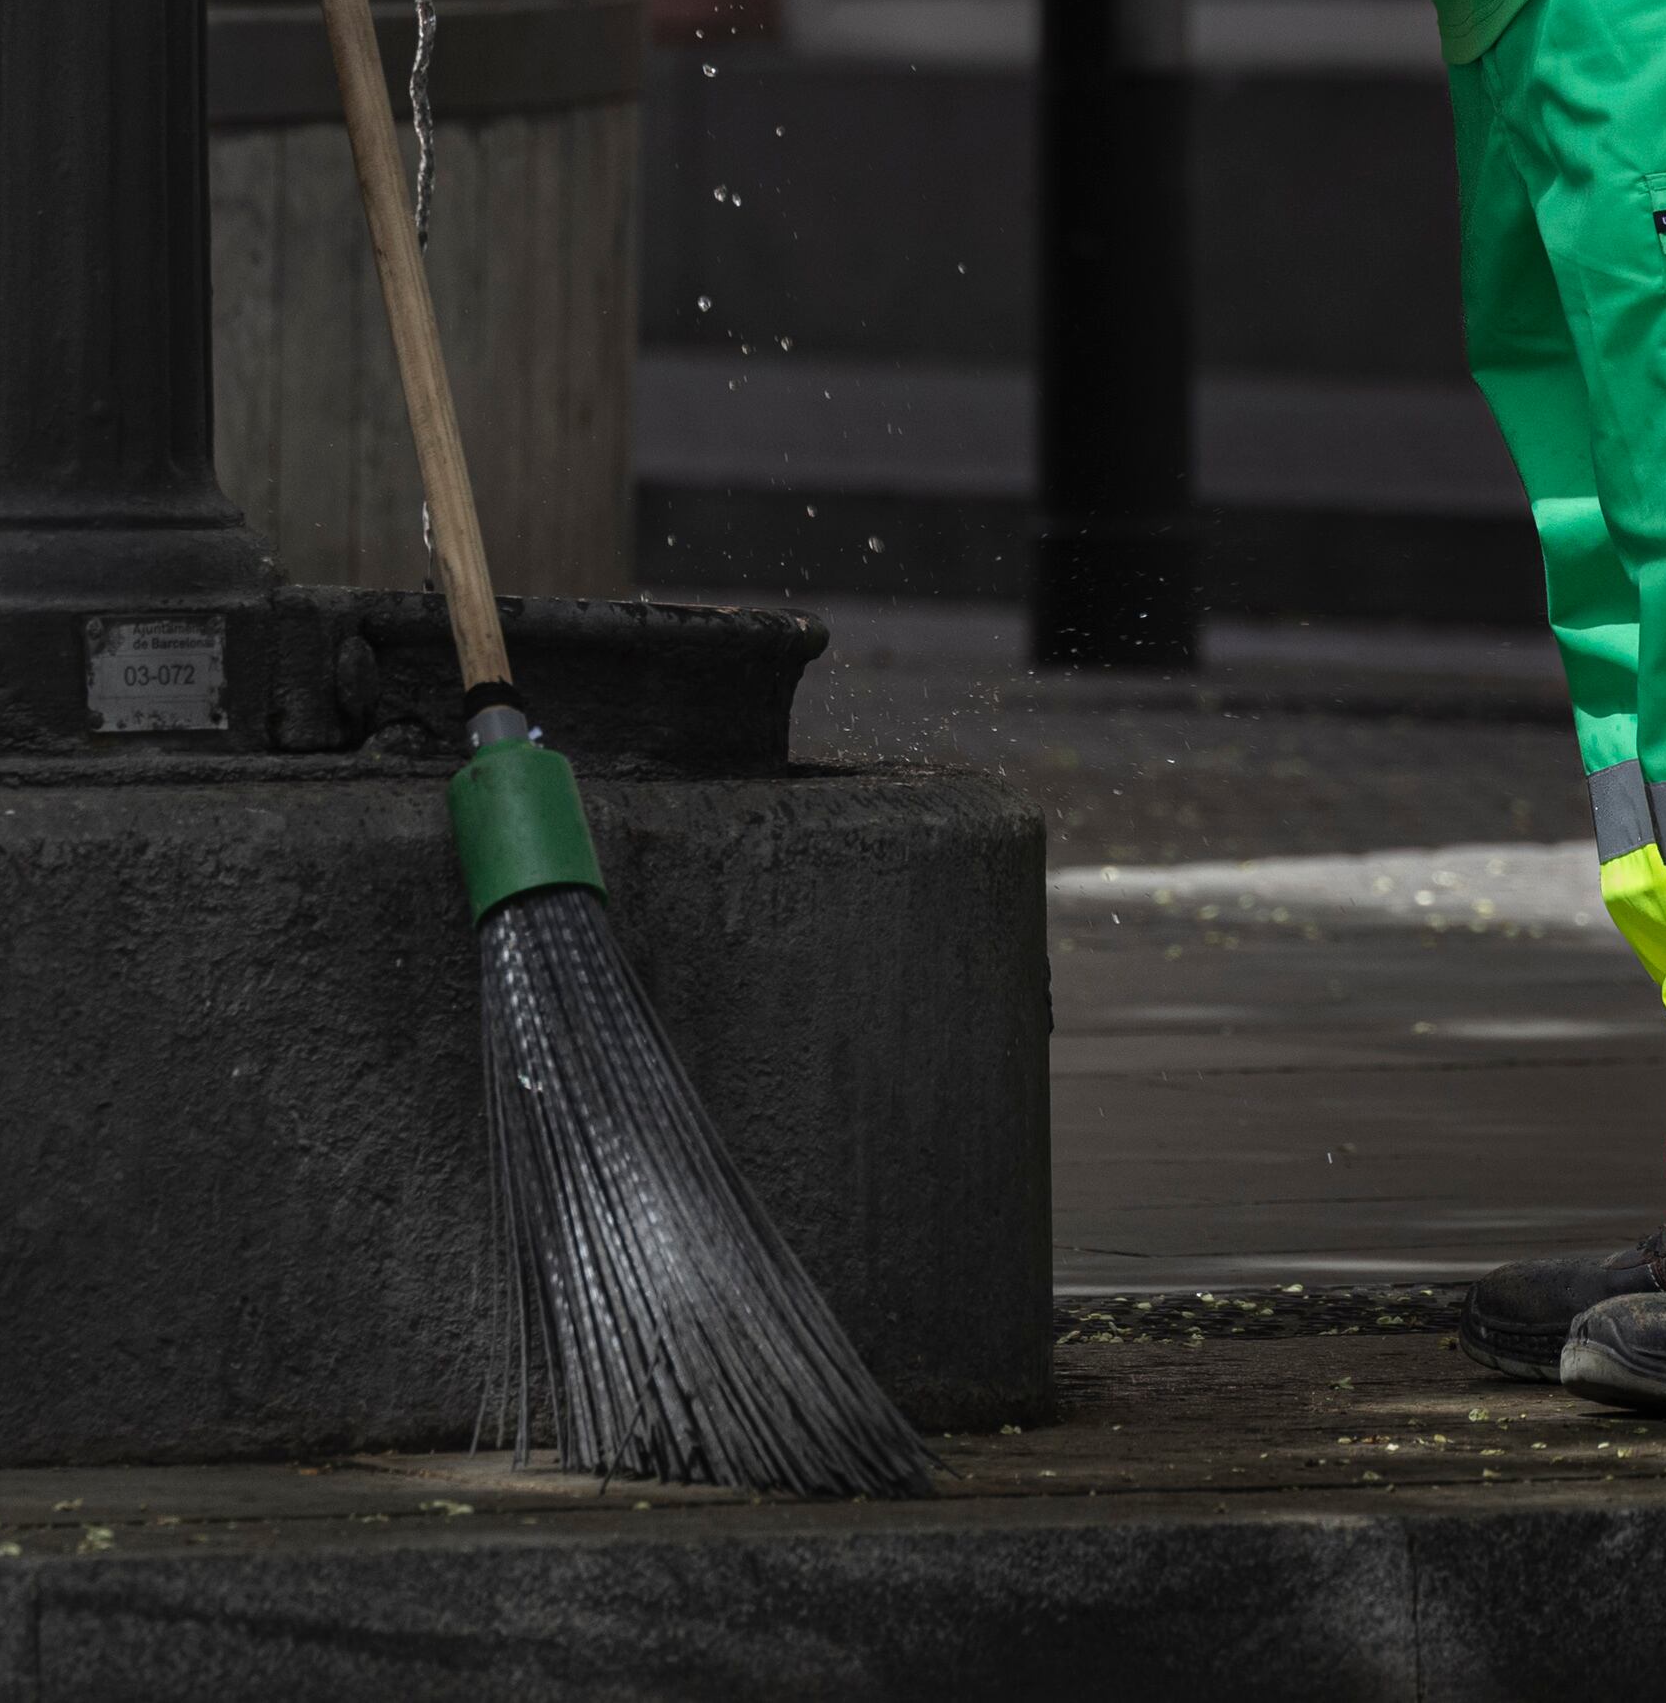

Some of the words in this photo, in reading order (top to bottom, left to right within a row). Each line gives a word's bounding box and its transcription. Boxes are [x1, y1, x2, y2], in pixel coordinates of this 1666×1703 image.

[133, 638, 148, 650] de
[152, 637, 214, 650] Barcelona
[124, 663, 196, 686] 03-072
